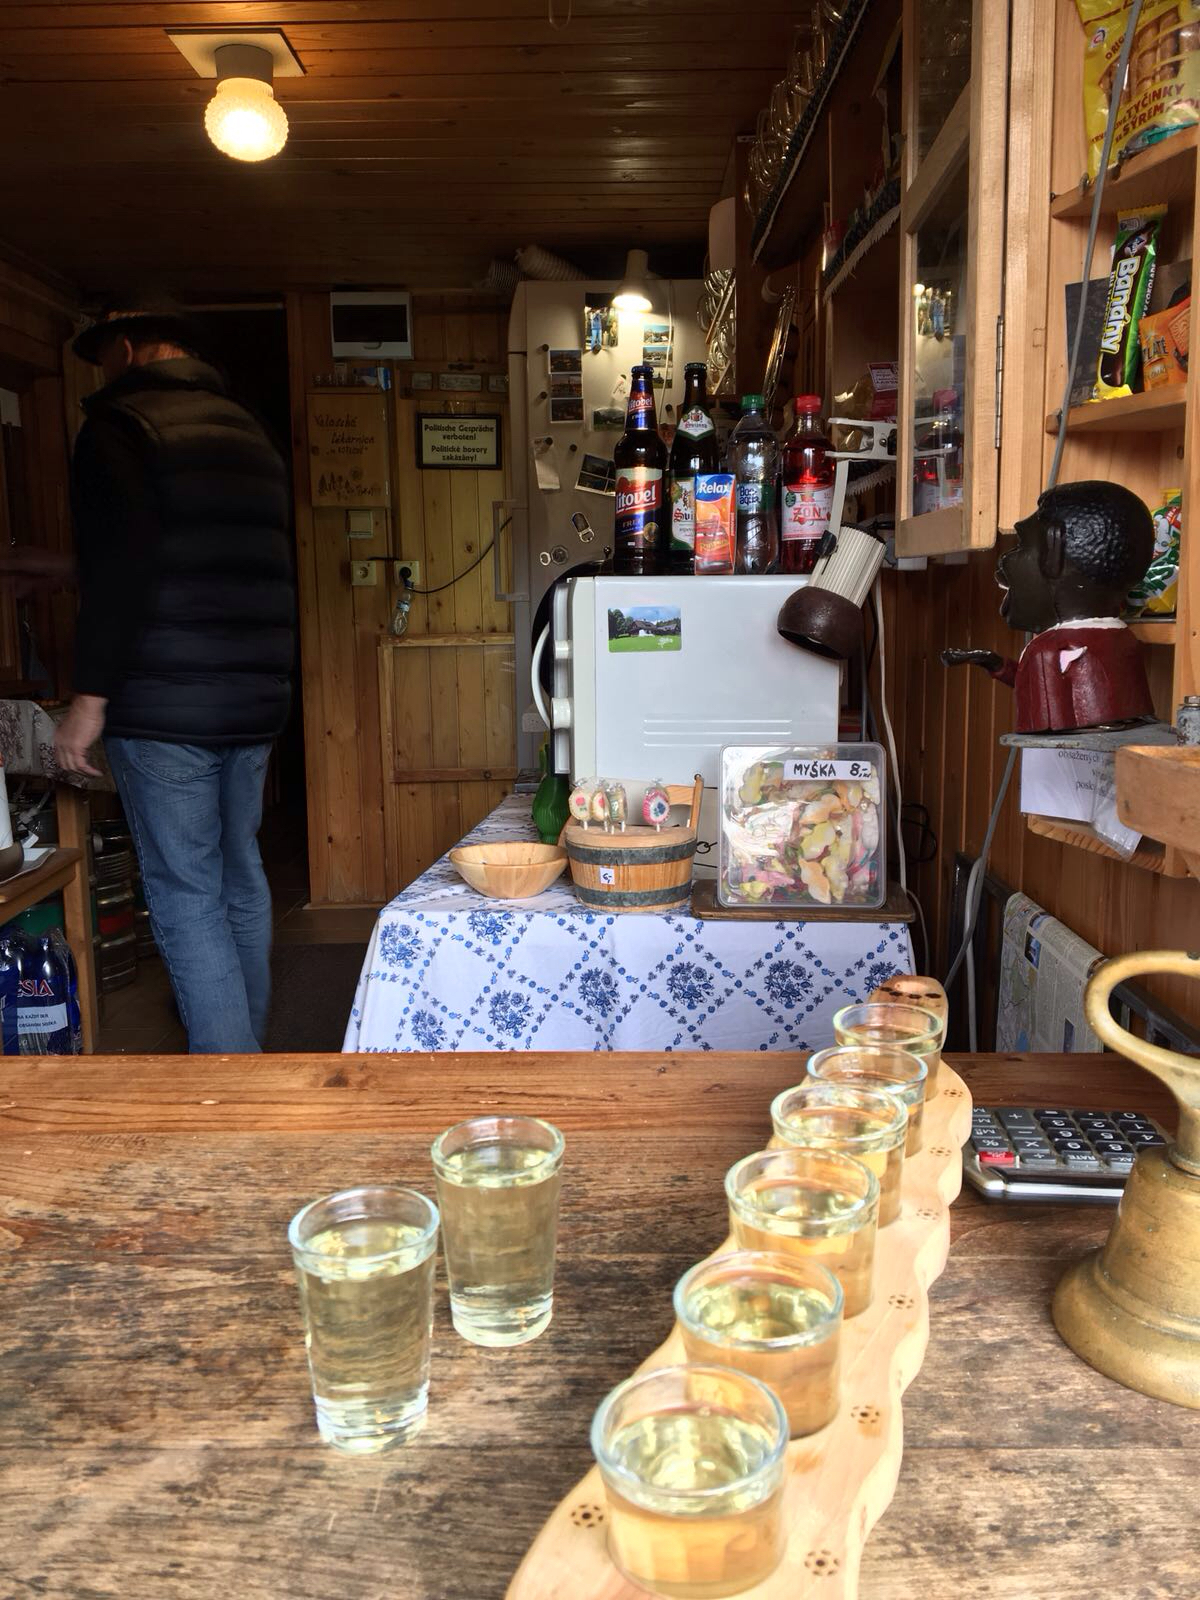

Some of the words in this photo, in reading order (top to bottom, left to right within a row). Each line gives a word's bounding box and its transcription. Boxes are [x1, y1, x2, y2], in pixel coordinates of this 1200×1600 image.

[424, 424, 456, 432] Politische
[699, 481, 730, 495] Relax
[793, 761, 837, 778] MYŠKA
[1059, 1130, 1073, 1138] 6
[1101, 1132, 1114, 1140] 5
